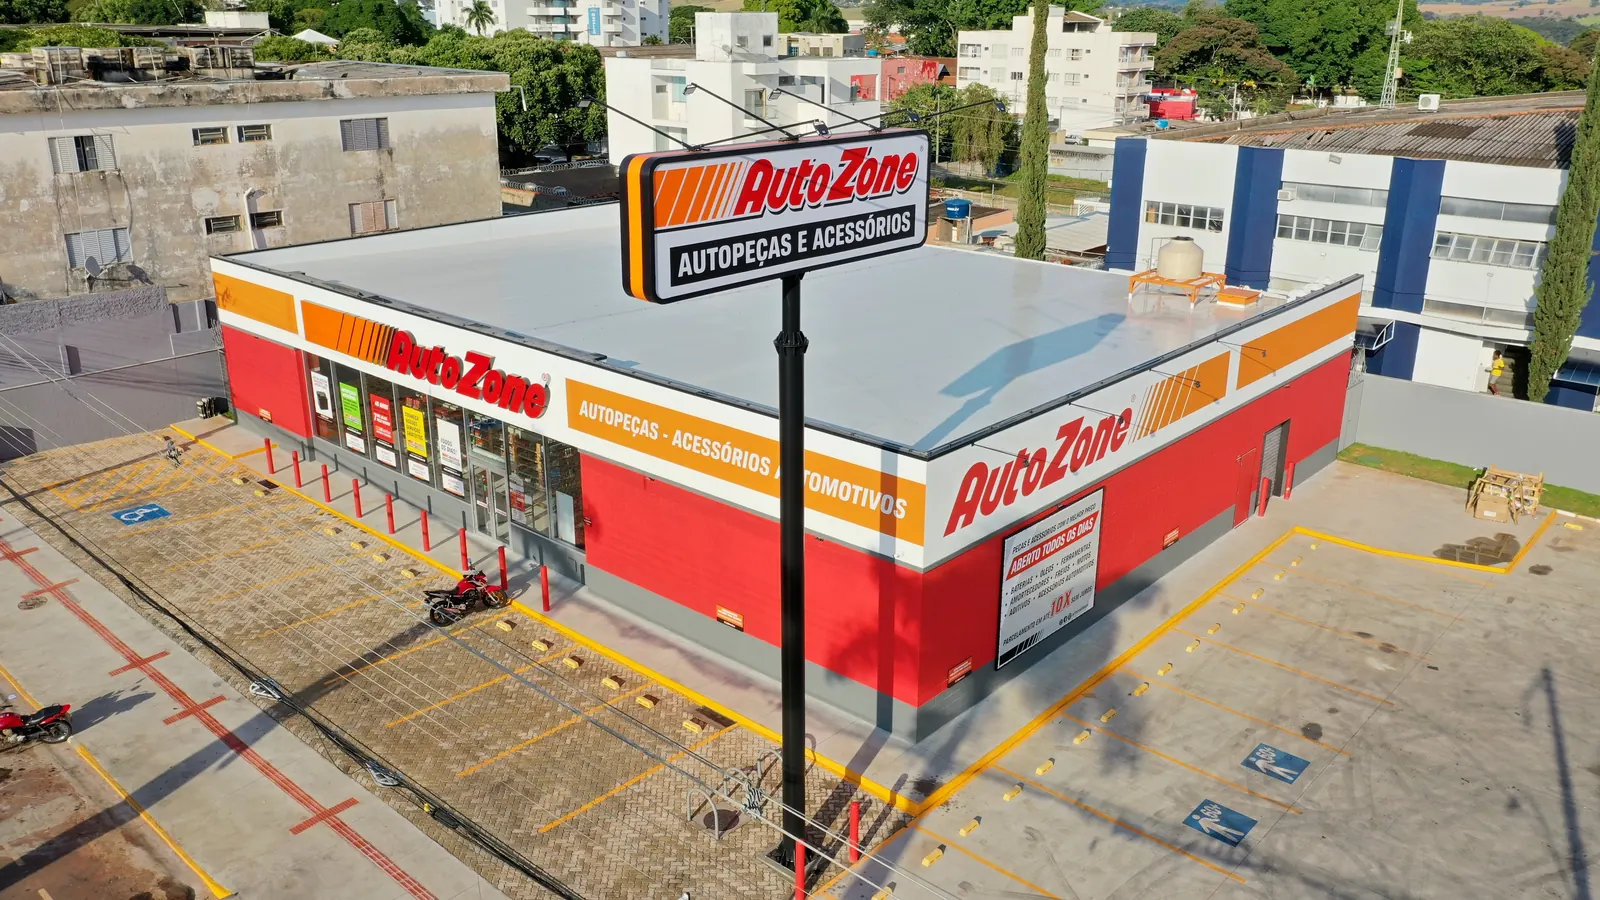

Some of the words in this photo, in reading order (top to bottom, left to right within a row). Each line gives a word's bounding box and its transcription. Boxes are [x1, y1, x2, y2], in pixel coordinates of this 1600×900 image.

[733, 147, 918, 217] AutoZone
[677, 233, 792, 278] AUTOPEÇAS
[797, 230, 808, 254] E
[812, 211, 911, 250] ACESSÓRIOS
[387, 330, 551, 419] AutoZone
[579, 399, 660, 442] AUTOPEÇAS
[671, 429, 771, 476] ACESSÓRIOS
[774, 465, 908, 519] TOMOTIVOS
[943, 407, 1132, 537] AutoZone
[1010, 547, 1041, 575] ABERTO
[1042, 532, 1066, 557] TODOS
[1066, 527, 1077, 543] OS
[1077, 517, 1094, 535] DIAS
[1010, 575, 1033, 595] BATERIAS
[1060, 541, 1092, 565] FERRAMENTAS
[1008, 597, 1031, 617] ADITIVOS
[1065, 558, 1095, 583] AUTOMOTIVOS
[1009, 576, 1050, 605] AMORTECEDORES
[1054, 563, 1071, 579] FREIOS
[1076, 551, 1092, 565] MOTOS
[1002, 620, 1036, 646] PARCELAMENTO
